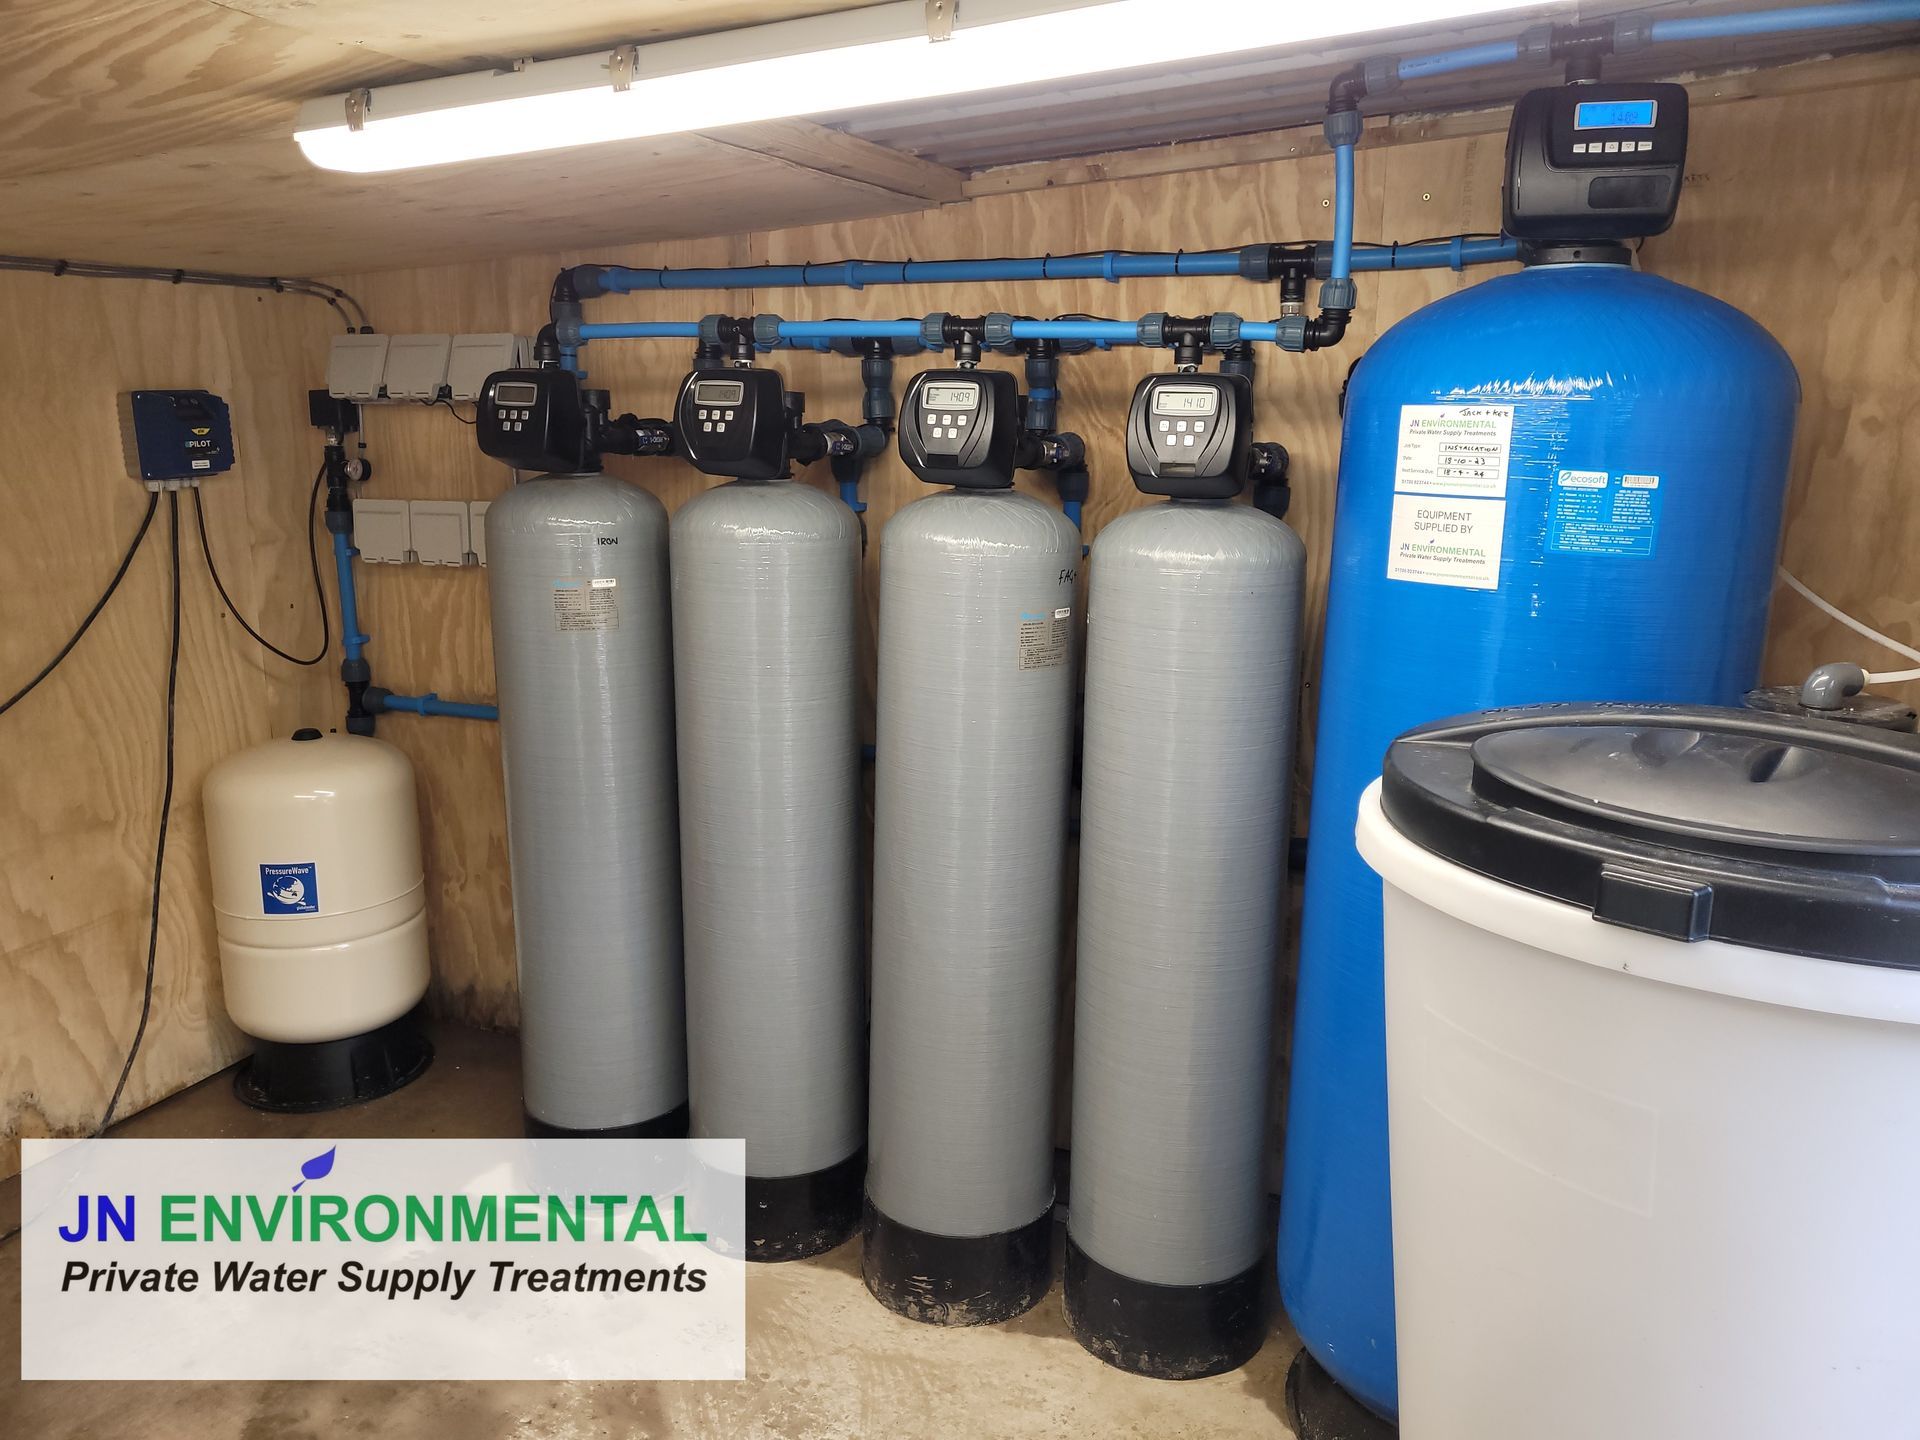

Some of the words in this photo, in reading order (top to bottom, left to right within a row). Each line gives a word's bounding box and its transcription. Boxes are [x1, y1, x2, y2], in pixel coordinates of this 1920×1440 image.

[950, 392, 971, 402] 1409
[1183, 397, 1206, 408] 1410
[1459, 408, 1482, 417] JACK
[1409, 420, 1420, 428] JN
[1421, 418, 1497, 429] ENVIRONMENTAL
[1444, 445, 1499, 453] INSTALLATION
[1570, 475, 1606, 484] ecosoft
[1417, 509, 1472, 521] EQUIPMENT
[1414, 521, 1459, 533] SUPPLIED
[1460, 524, 1474, 534] BY
[597, 537, 619, 546] IRON
[1400, 542, 1410, 551] JN
[1411, 543, 1487, 557] ENVIRONMENTAL
[1433, 555, 1452, 563] Supply
[1453, 557, 1486, 565] Treatments
[265, 867, 309, 875] PressureWave
